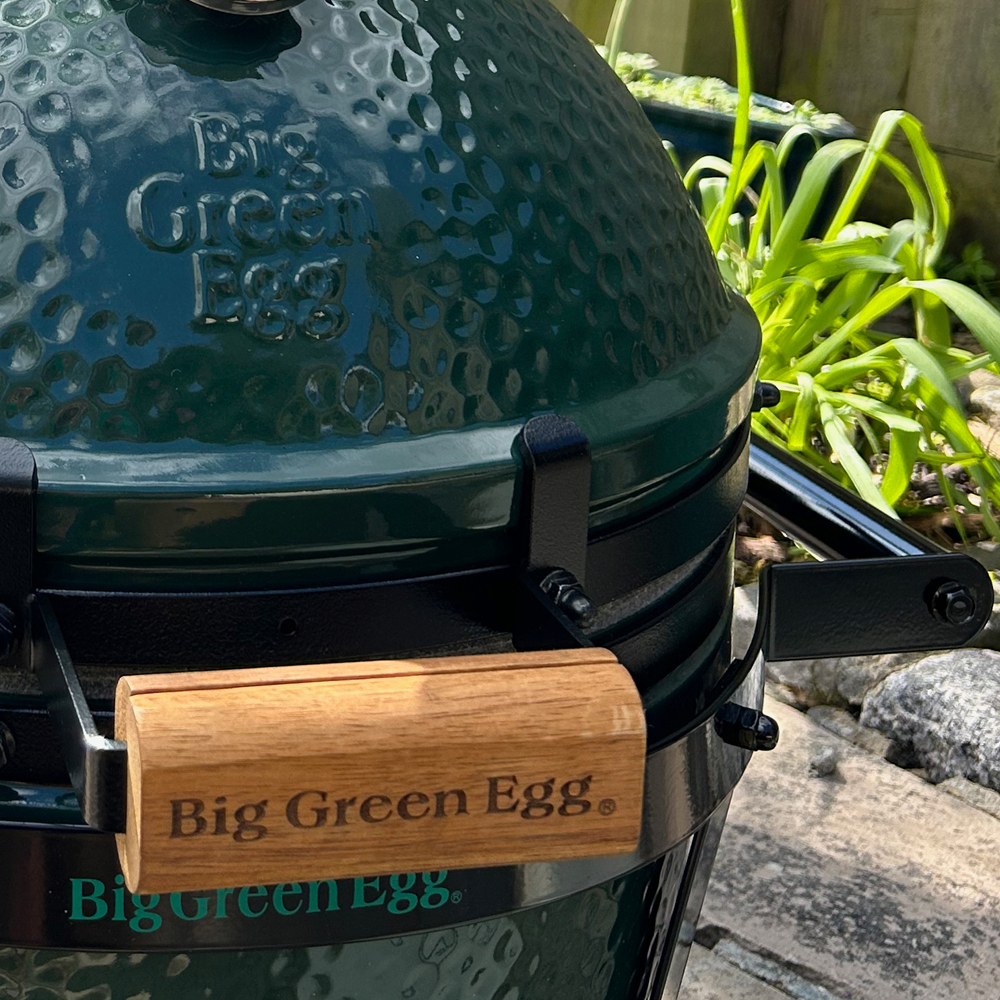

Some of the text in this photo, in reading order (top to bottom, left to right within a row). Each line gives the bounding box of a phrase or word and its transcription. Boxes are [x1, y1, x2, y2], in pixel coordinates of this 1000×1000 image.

[189, 110, 328, 190] Big
[126, 171, 382, 253] Green
[190, 249, 349, 341] Egg
[168, 796, 269, 843] Big
[285, 788, 470, 830] Green
[69, 874, 163, 933] Big
[169, 879, 340, 921] Green
